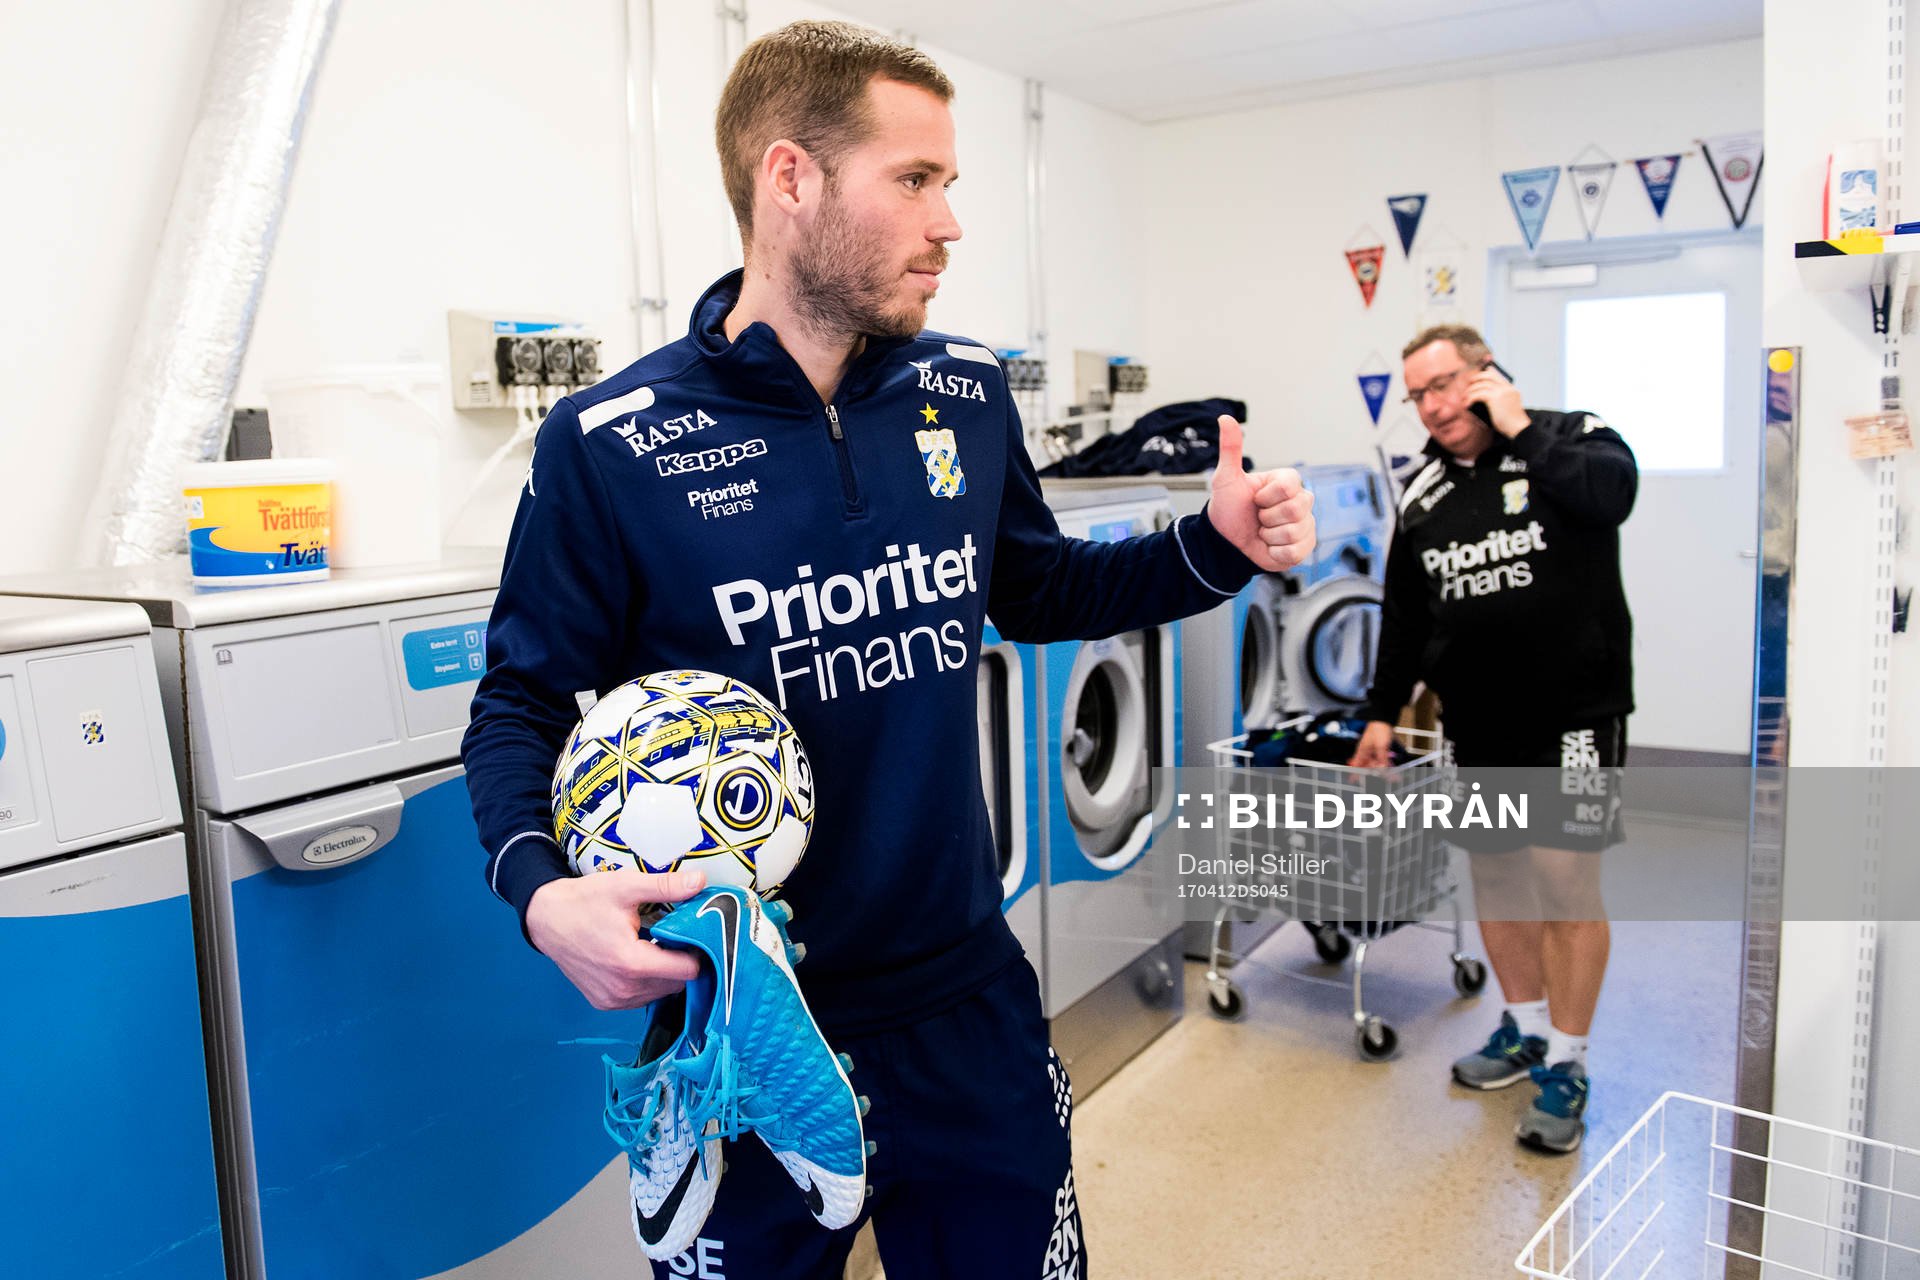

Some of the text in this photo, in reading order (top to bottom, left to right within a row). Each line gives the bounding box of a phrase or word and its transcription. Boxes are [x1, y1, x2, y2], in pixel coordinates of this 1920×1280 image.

[917, 368, 987, 402] RASTA
[625, 408, 718, 458] RASTA
[656, 438, 768, 477] Kappa
[687, 478, 759, 507] Prioritet
[701, 498, 754, 520] Finans
[1421, 520, 1548, 577] Prioritet
[712, 534, 978, 646] Prioritet
[1440, 561, 1533, 602] Finans
[771, 619, 968, 711] Finans
[1561, 729, 1595, 751] SE
[1561, 750, 1600, 773] RN
[1560, 770, 1608, 797] EKE
[323, 835, 367, 853] Electrolux
